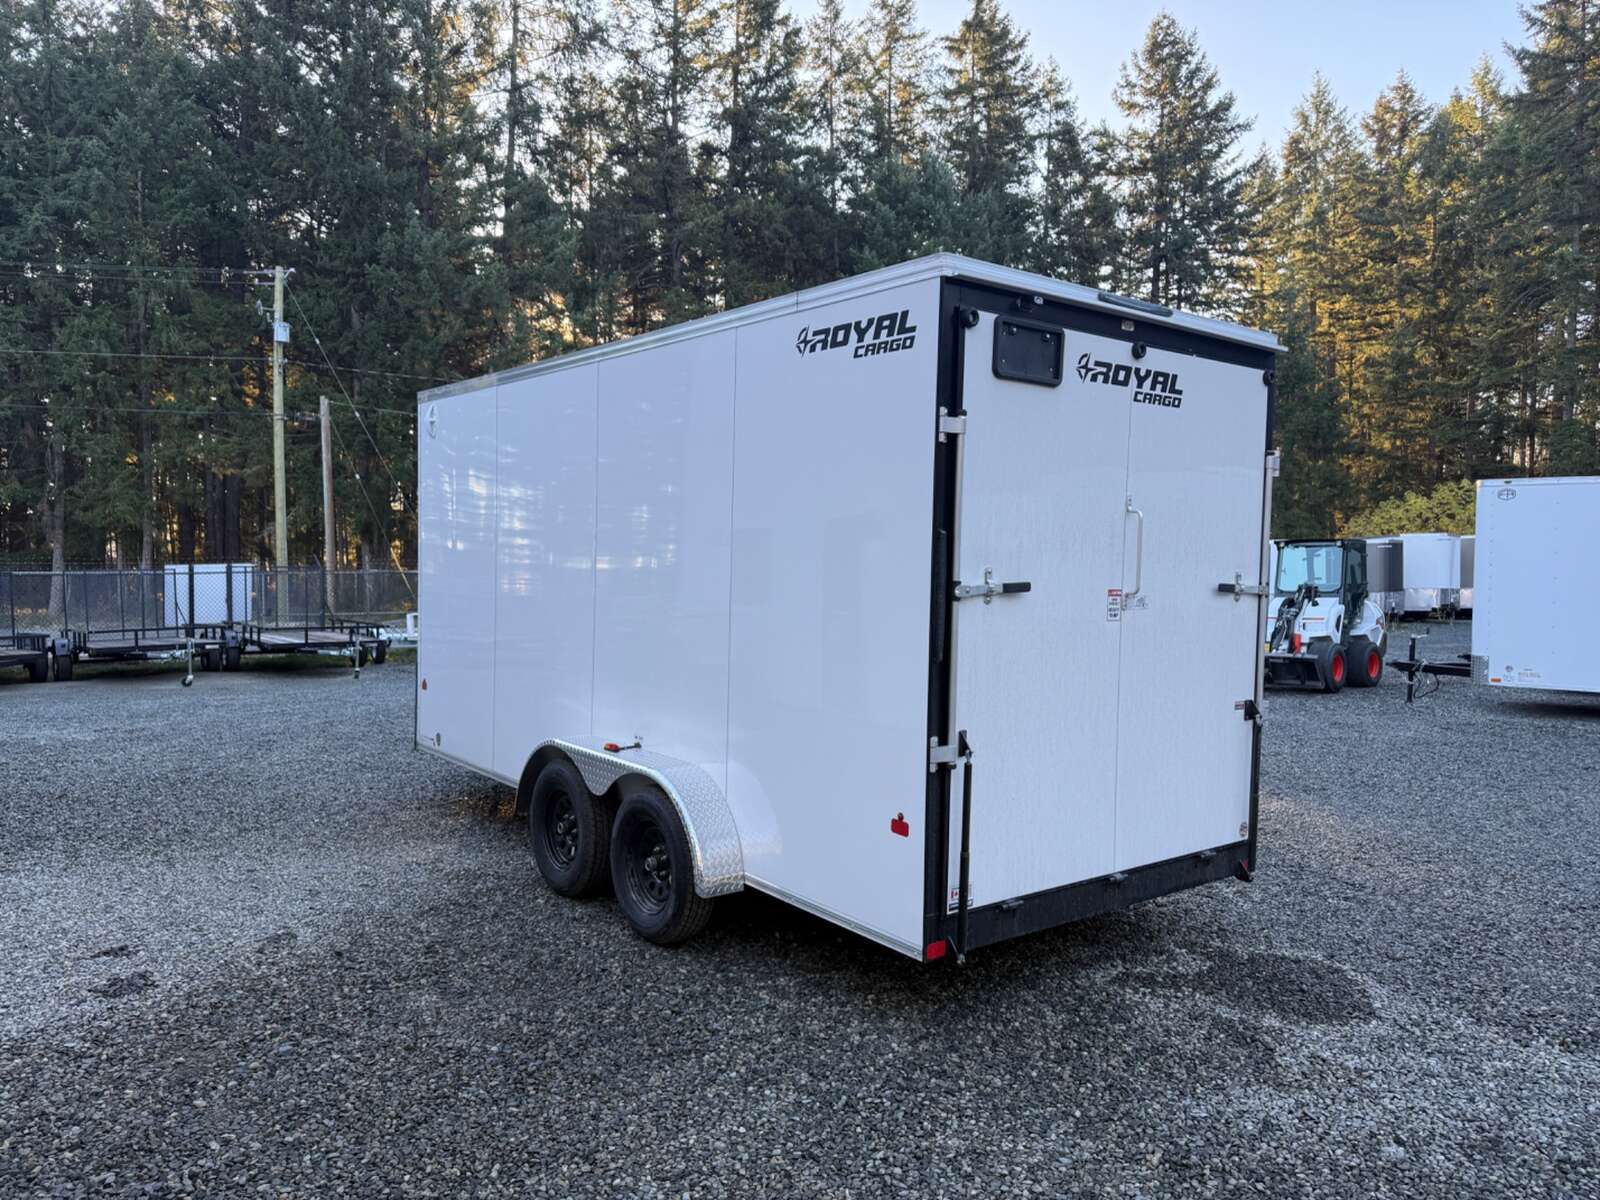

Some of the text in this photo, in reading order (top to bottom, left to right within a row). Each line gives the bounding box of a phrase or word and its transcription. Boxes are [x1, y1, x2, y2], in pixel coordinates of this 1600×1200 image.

[809, 309, 918, 354] ROYAL
[853, 335, 916, 359] CARGO
[1090, 360, 1184, 395] ROYAL
[1133, 390, 1182, 409] CARGO
